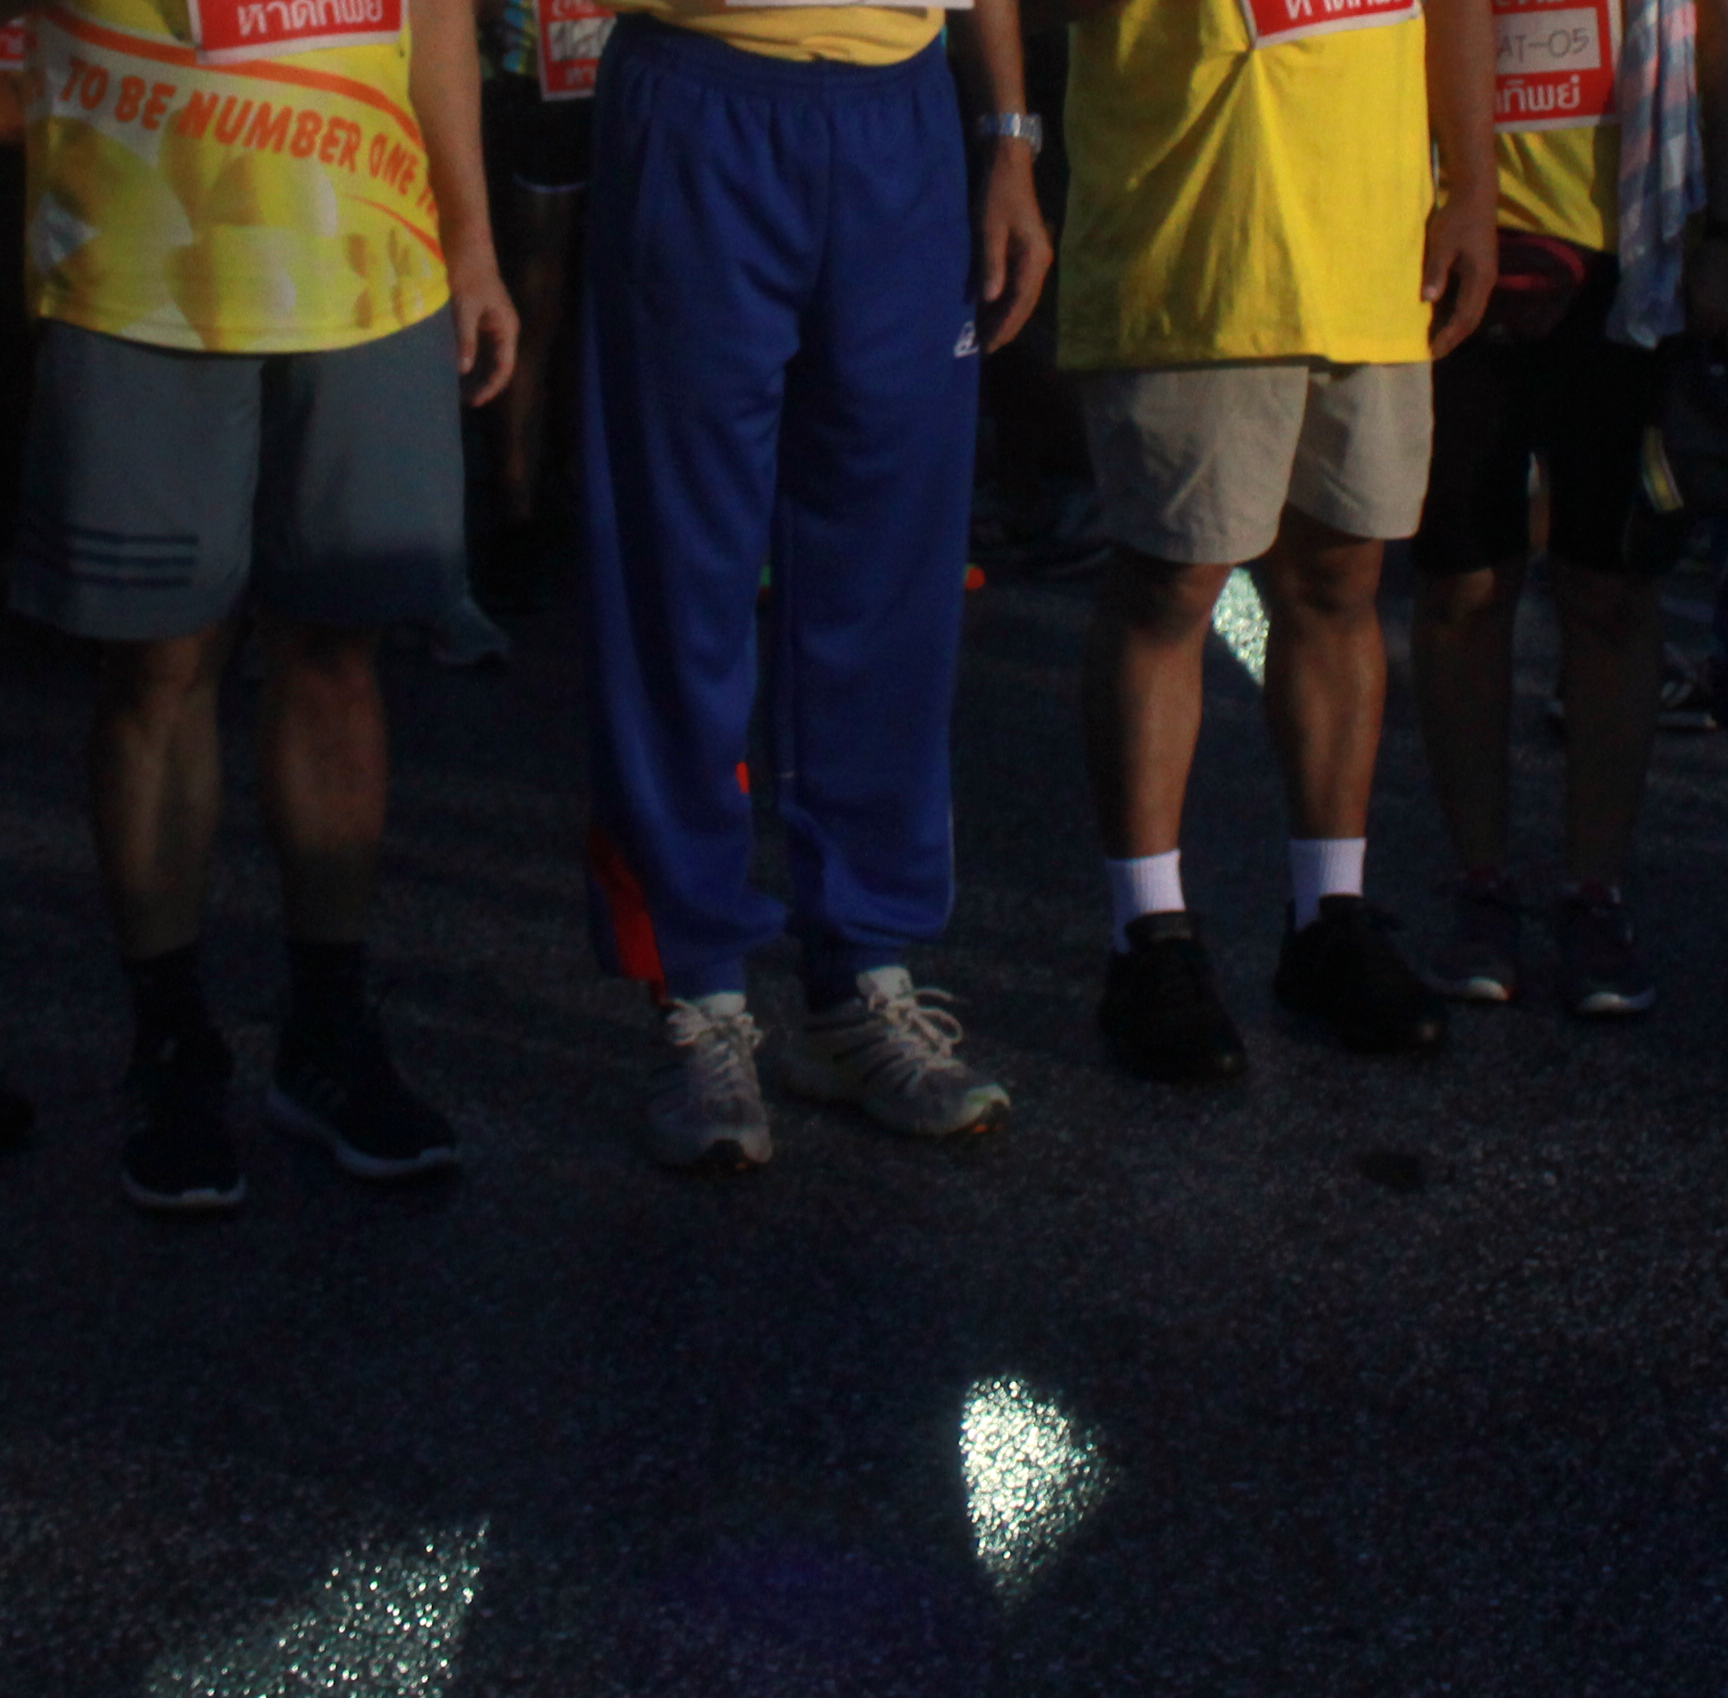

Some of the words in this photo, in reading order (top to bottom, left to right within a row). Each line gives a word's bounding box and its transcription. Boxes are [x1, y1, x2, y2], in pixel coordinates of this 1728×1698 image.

[60, 56, 110, 111] TO
[114, 74, 176, 131] BE
[176, 89, 362, 173] NUMBER
[369, 133, 420, 196] ONE
[1494, 74, 1582, 115] ทิพย์
